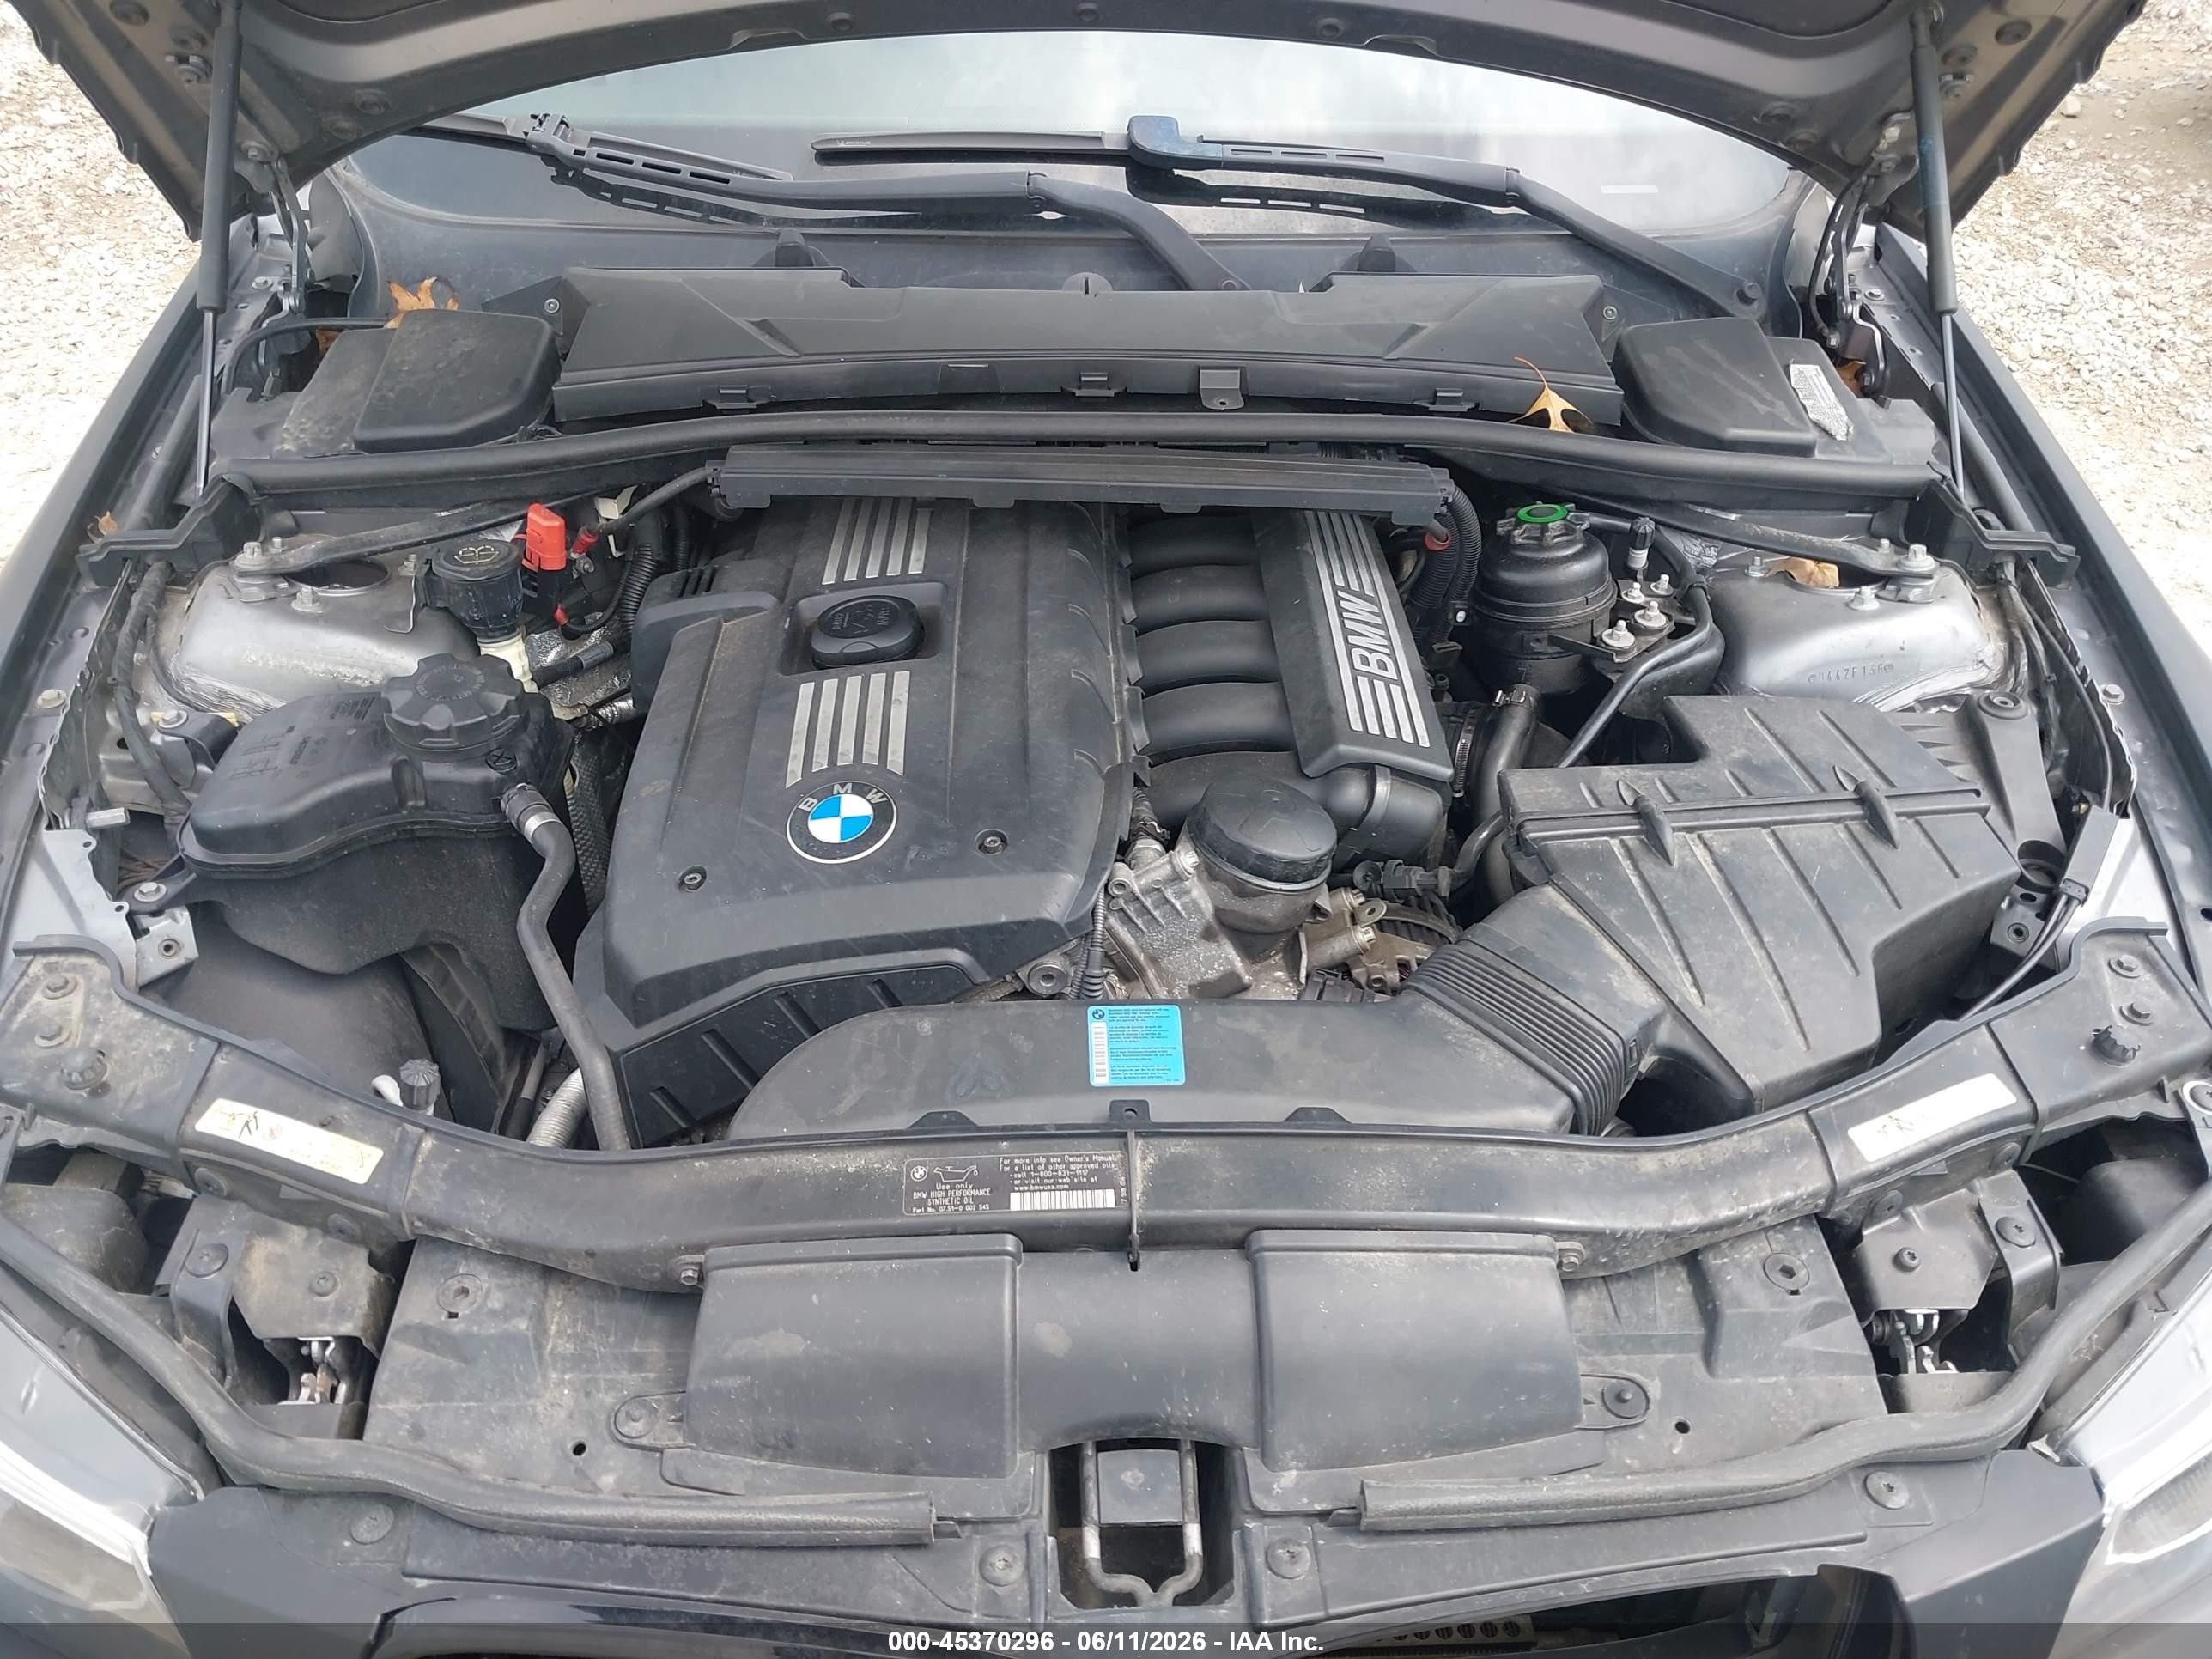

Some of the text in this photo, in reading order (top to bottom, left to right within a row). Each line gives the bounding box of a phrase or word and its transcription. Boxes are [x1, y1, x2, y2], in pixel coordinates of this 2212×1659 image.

[1337, 590, 1399, 680] BMW
[798, 782, 888, 811] BMW
[955, 1182, 974, 1190] only
[913, 1191, 927, 1200] BMW
[947, 1188, 991, 1197] PERFORMANCE
[927, 1197, 961, 1206] SYNTHETIC
